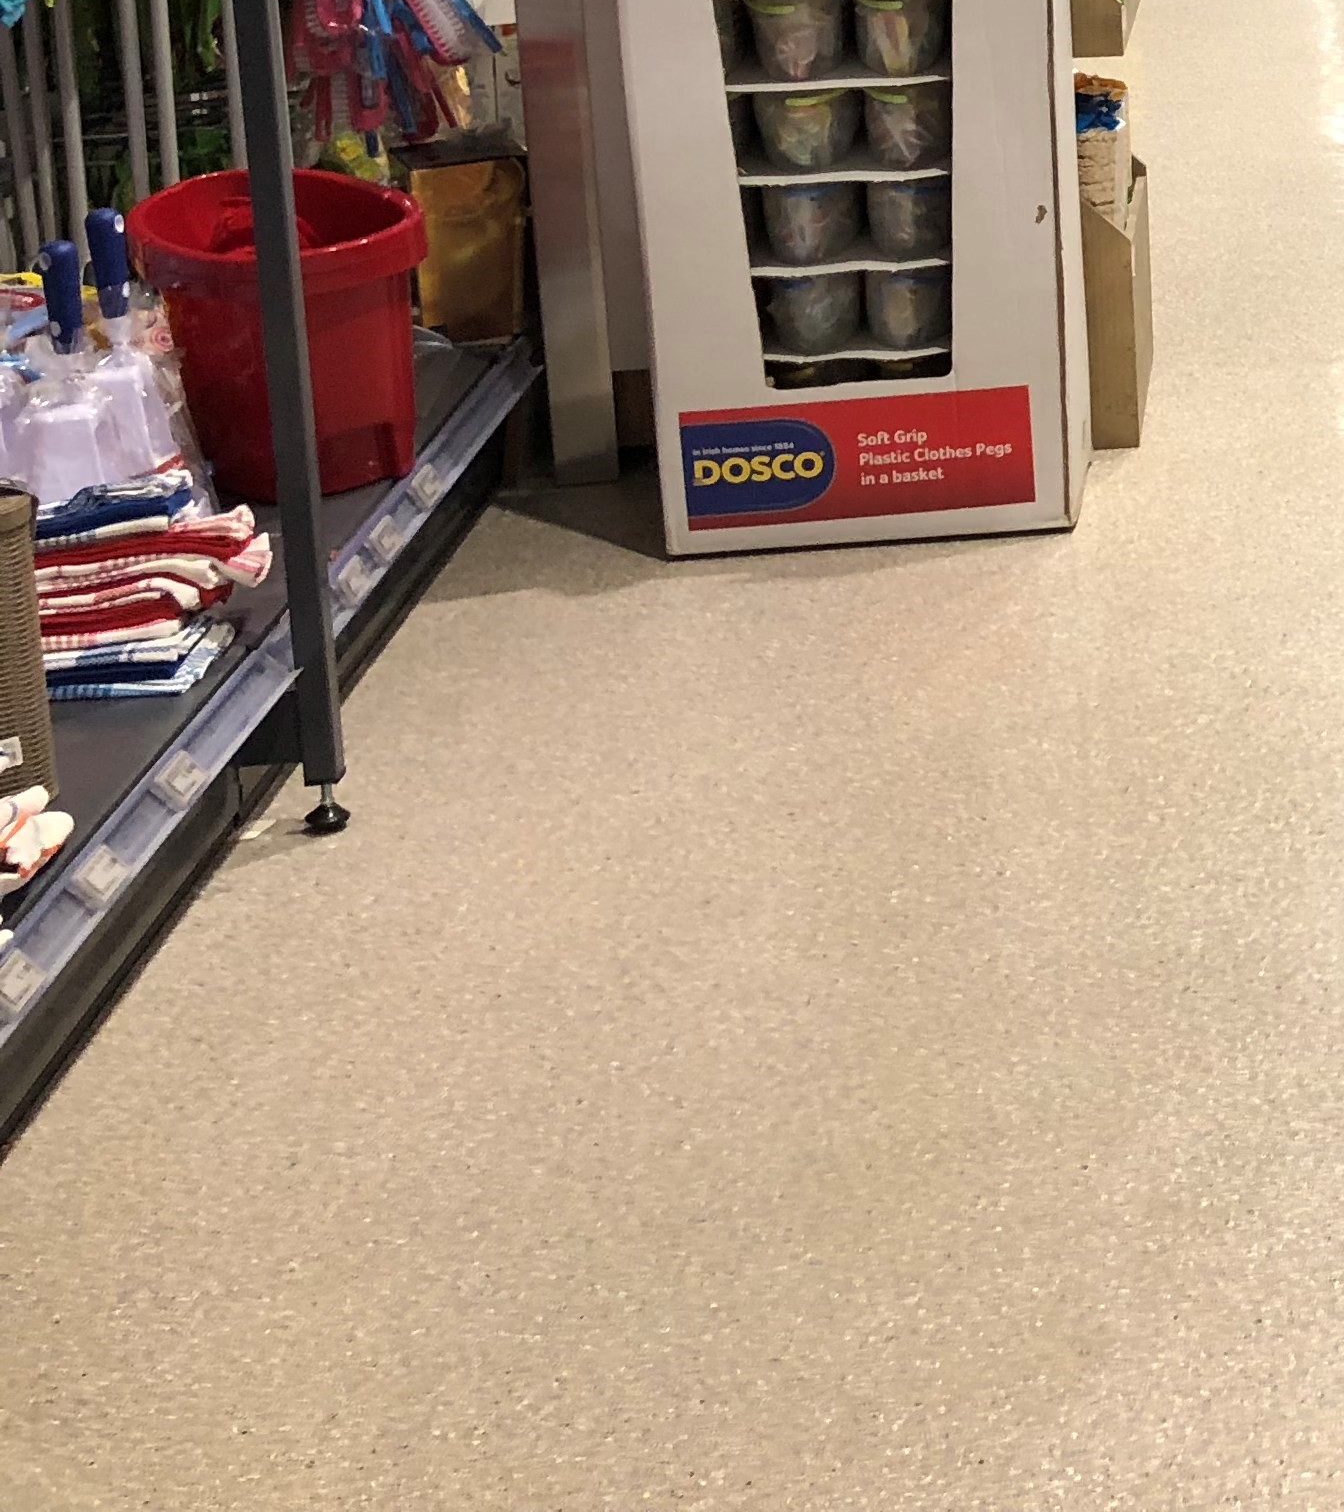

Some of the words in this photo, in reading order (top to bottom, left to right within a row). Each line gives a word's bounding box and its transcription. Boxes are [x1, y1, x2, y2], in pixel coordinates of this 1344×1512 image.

[857, 431, 890, 447] Soft
[894, 428, 927, 445] Grip
[722, 444, 749, 454] homes
[751, 443, 773, 452] since
[859, 449, 910, 466] Plastic
[914, 445, 972, 463] Clothes
[976, 442, 1012, 459] Pegs
[693, 451, 824, 486] DOSCO
[861, 472, 875, 486] in
[879, 473, 889, 484] a
[892, 467, 944, 483] basket
